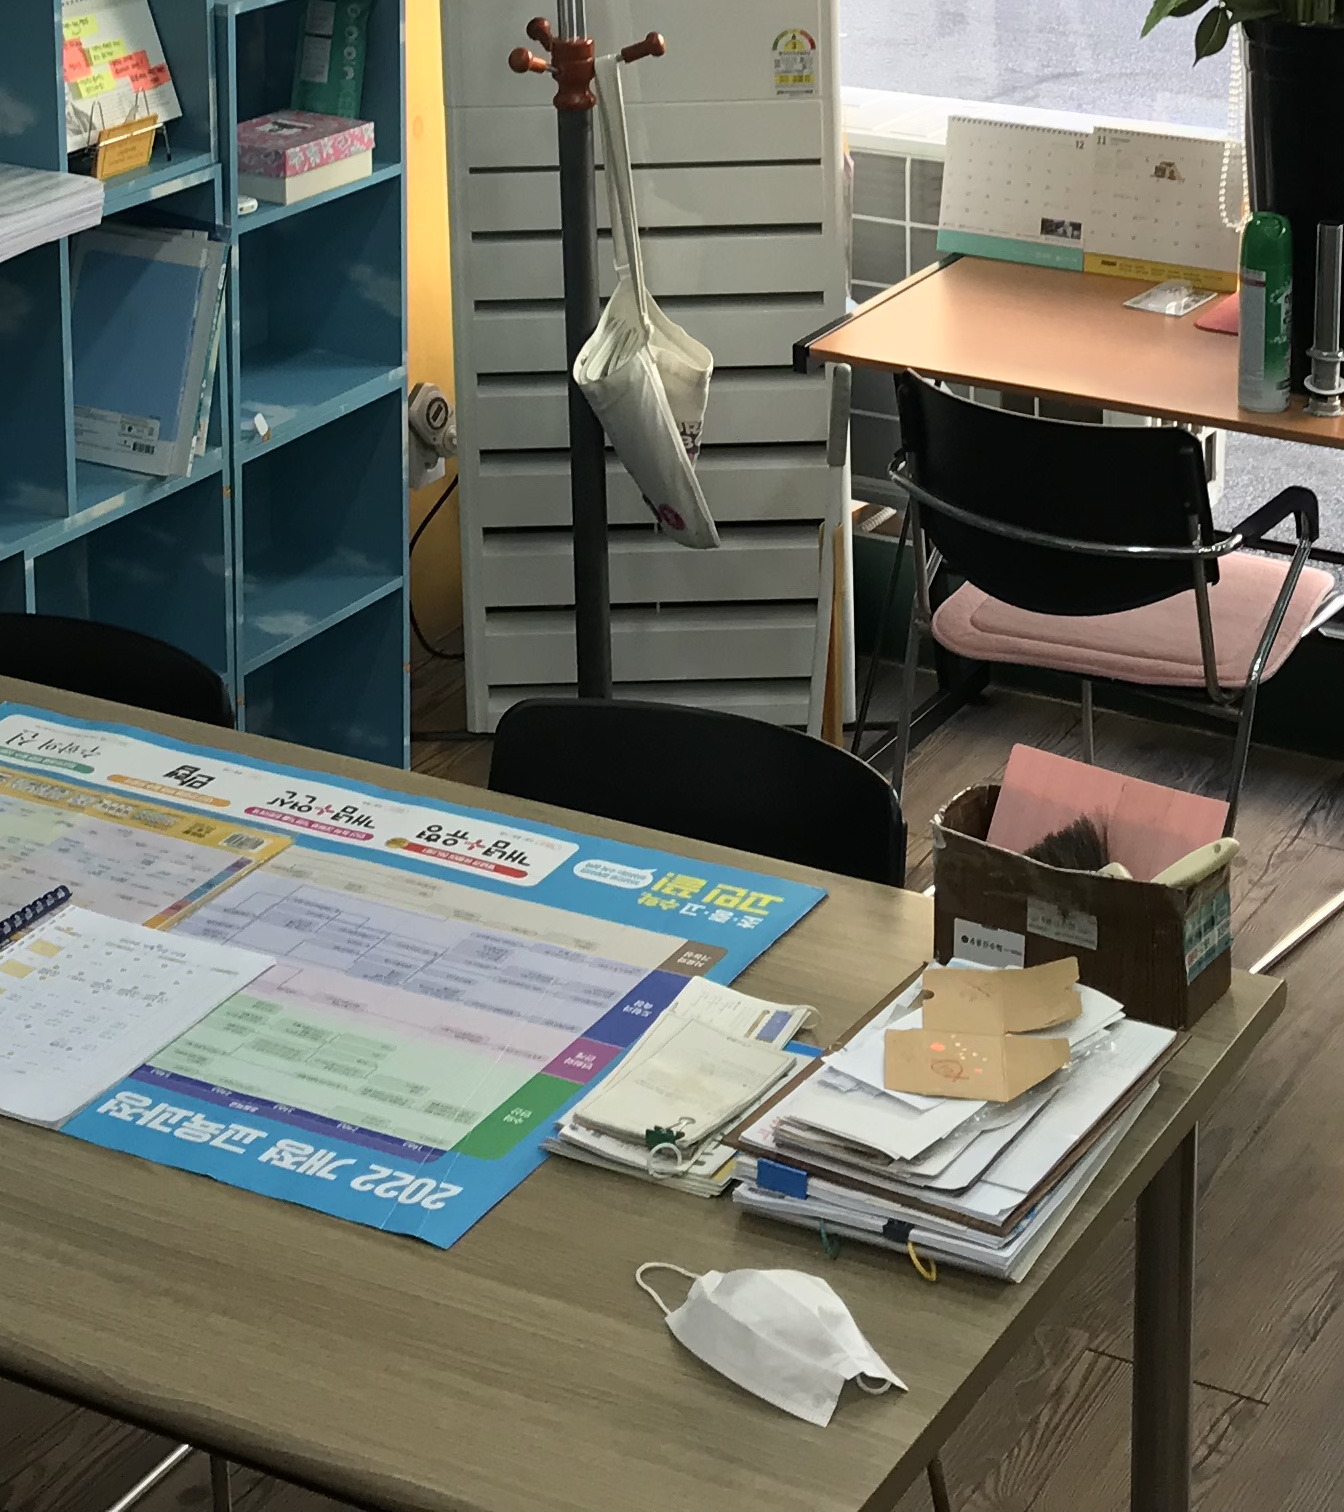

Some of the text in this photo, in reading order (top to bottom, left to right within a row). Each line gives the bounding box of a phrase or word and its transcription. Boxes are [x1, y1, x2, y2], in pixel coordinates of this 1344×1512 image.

[266, 790, 376, 831] 개념+연산
[415, 823, 531, 868] 개념+유형
[650, 871, 709, 899] 끝!
[701, 882, 785, 916] 고민
[95, 1090, 464, 1211] 2022 개정 교육과정
